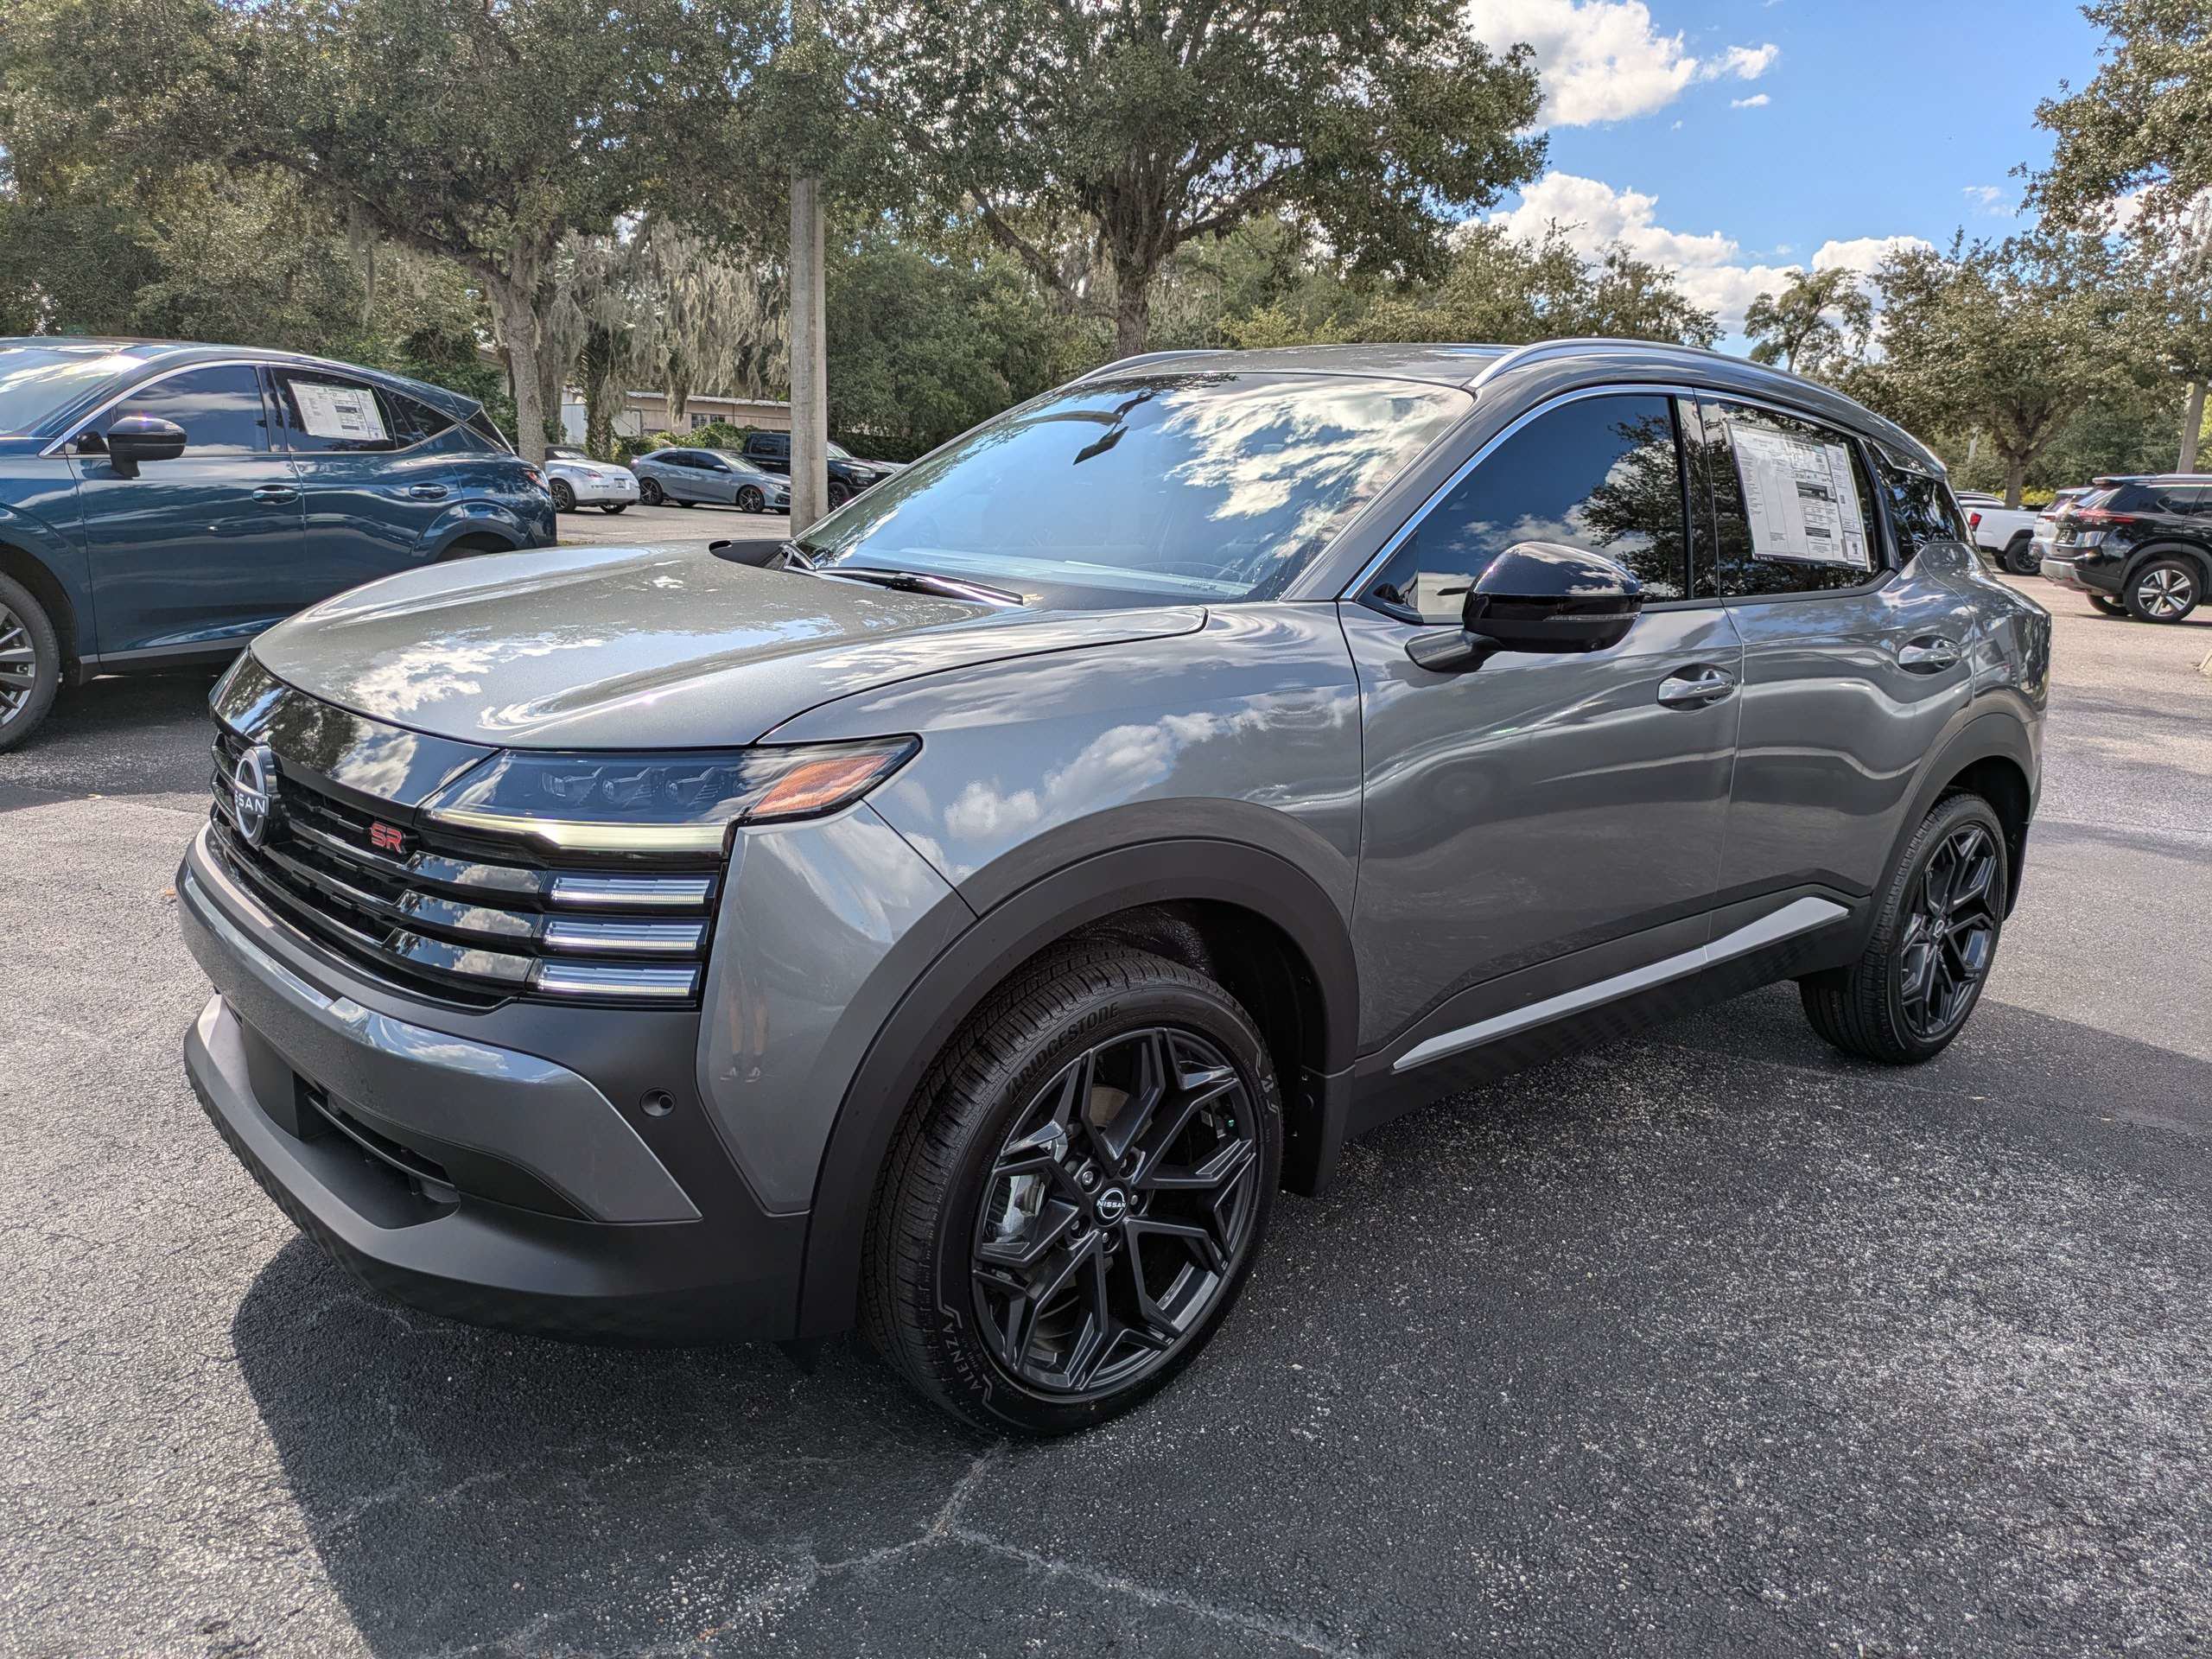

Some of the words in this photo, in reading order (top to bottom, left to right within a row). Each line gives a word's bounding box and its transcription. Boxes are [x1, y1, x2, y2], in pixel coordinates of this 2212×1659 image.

[372, 822, 403, 854] SR
[1007, 1001, 1120, 1097] BRIDGESTONE
[1096, 1199, 1126, 1208] NISSAN
[942, 1323, 982, 1389] ALENZA
